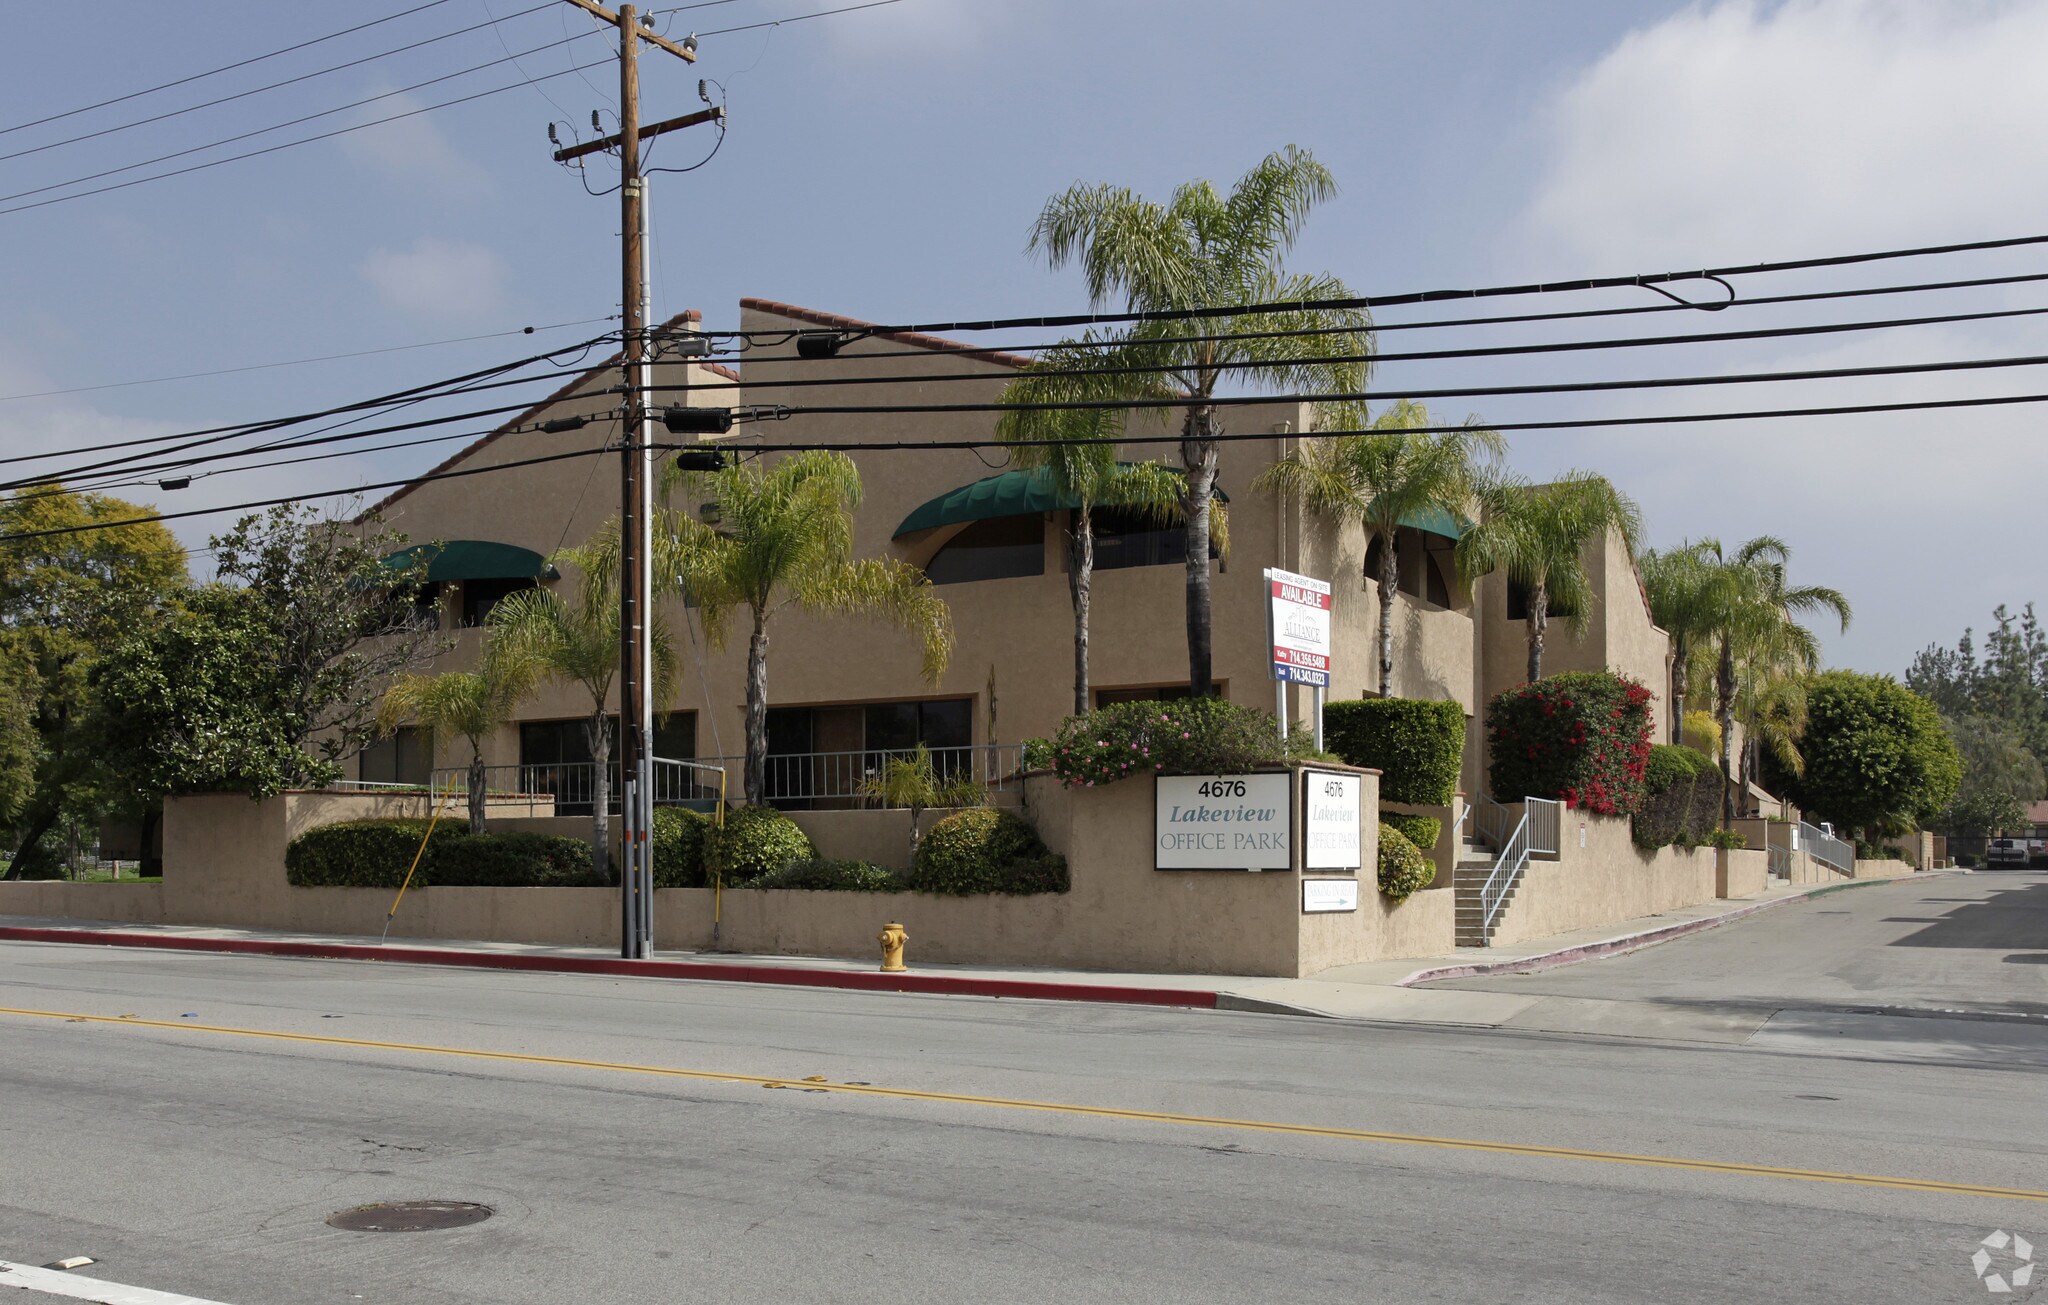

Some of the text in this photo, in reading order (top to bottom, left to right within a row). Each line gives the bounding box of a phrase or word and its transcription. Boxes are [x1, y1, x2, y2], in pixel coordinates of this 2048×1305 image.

[1274, 571, 1293, 582] LEASING
[1295, 577, 1309, 586] AGENT
[1319, 583, 1328, 591] SITE
[1281, 584, 1322, 607] AVAILABLE
[1284, 621, 1320, 642] ALLIANCE
[1198, 780, 1246, 797] 4676
[1324, 781, 1343, 797] 4676
[1169, 805, 1276, 823] Lakeview
[1312, 804, 1354, 822] Lakeview
[1160, 832, 1286, 850] OFFICE PARK
[1309, 832, 1358, 849] OFFICE PARK
[1308, 884, 1331, 897] PARKING
